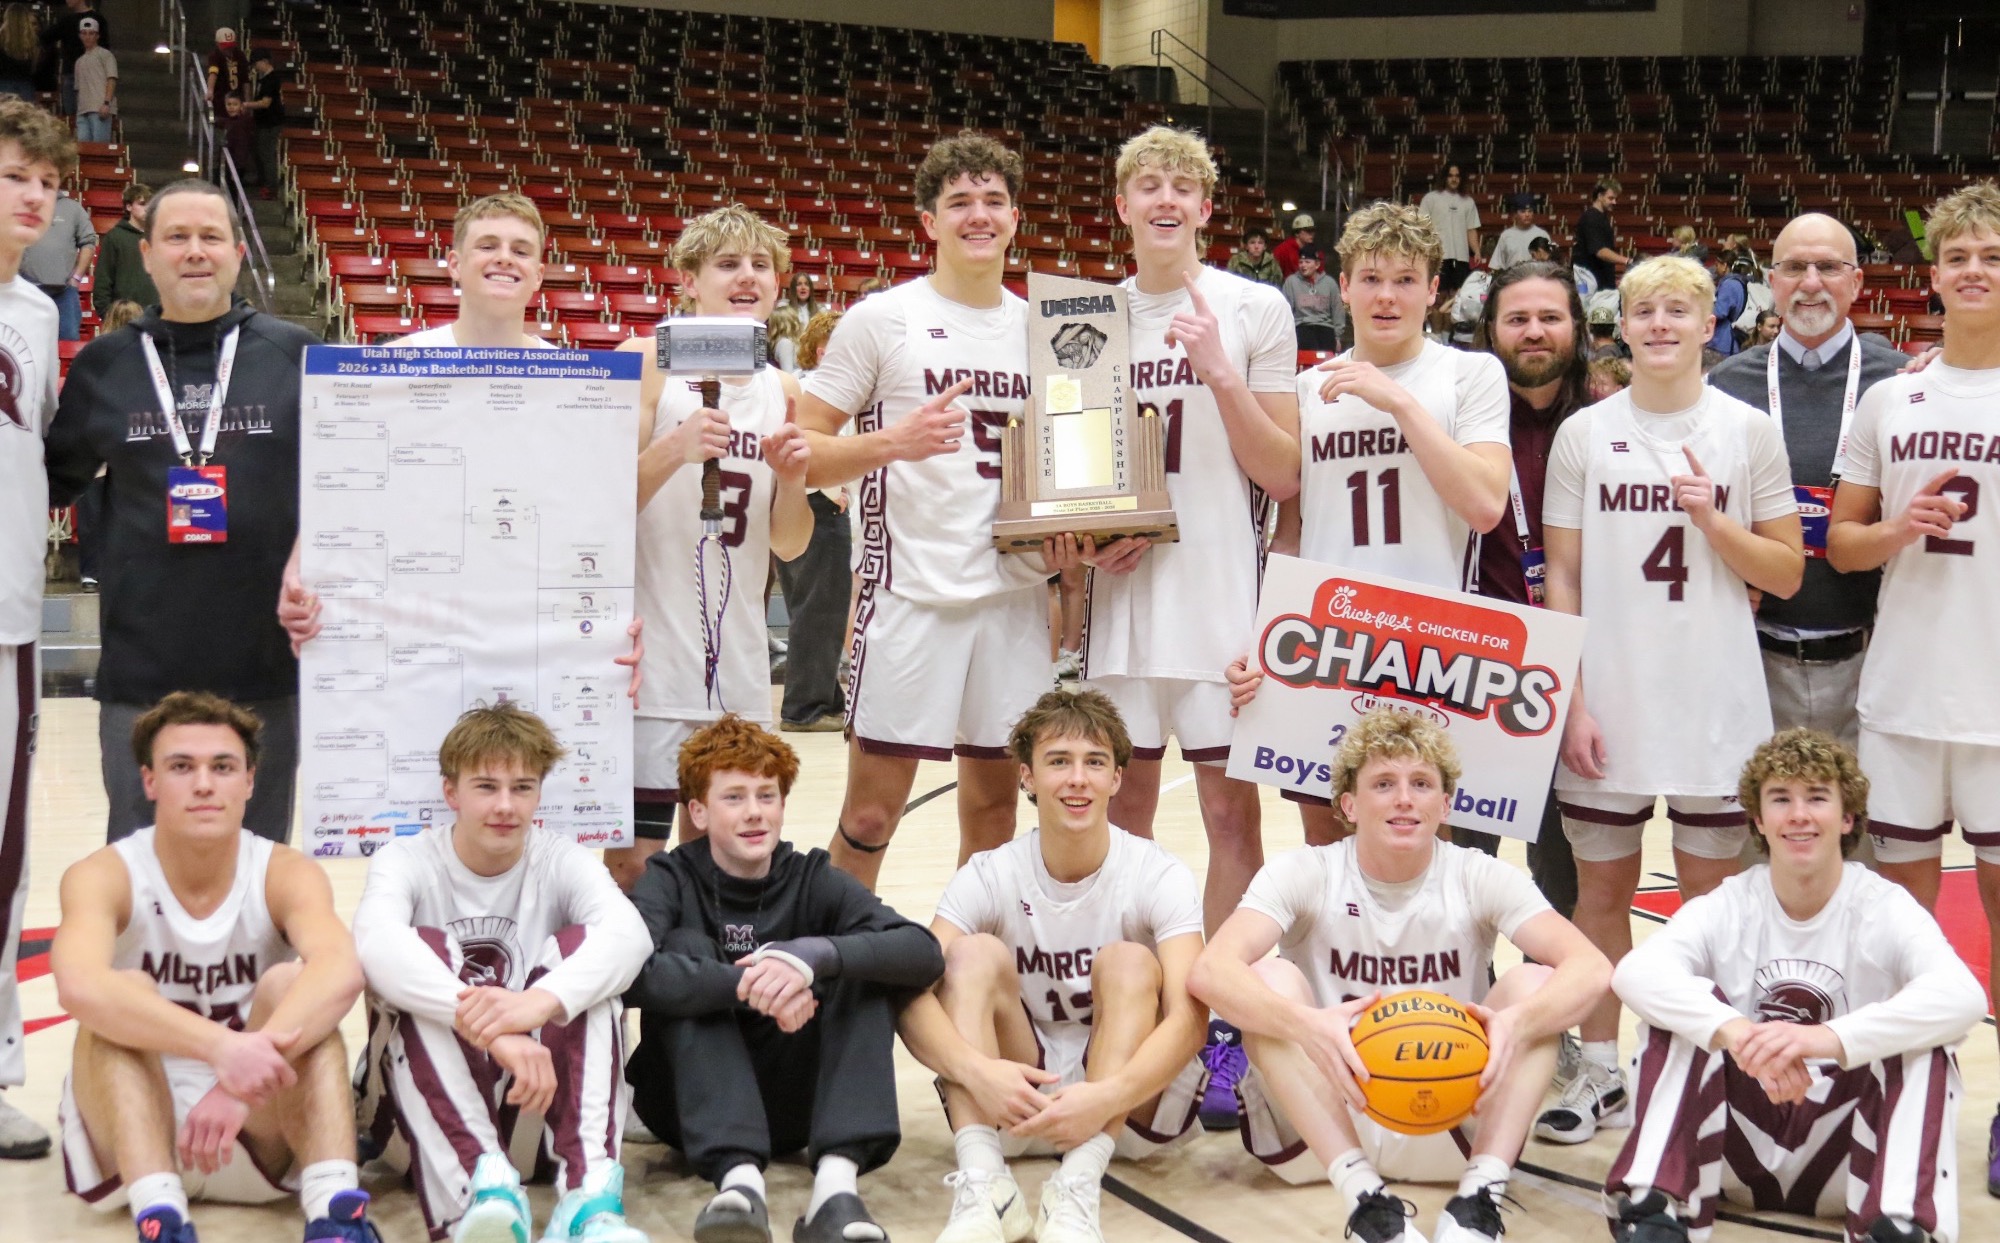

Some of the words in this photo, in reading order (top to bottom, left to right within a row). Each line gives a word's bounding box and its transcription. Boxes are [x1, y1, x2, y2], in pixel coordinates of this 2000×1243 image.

[363, 348, 390, 359] Utah
[393, 349, 421, 361] High
[423, 349, 462, 359] School
[464, 349, 519, 360] Activities
[522, 351, 589, 361] Association
[338, 362, 368, 373] 2026
[380, 364, 396, 374] 3A
[399, 364, 428, 376] Boys
[431, 364, 492, 375] Basketball
[496, 365, 524, 375] State
[528, 365, 611, 378] Championship
[924, 368, 1031, 400] MORGA
[1130, 357, 1204, 390] RGA
[177, 401, 212, 410] MORGA
[184, 384, 213, 401] M
[1113, 364, 1125, 491] CHAMPIONSHIP
[1043, 425, 1052, 477] STATE
[1312, 427, 1413, 463] MORGA
[1891, 431, 2000, 464] MORGA
[1346, 467, 1402, 547] 11
[1600, 483, 1731, 513] MORN
[184, 533, 212, 542] COACH
[1641, 525, 1689, 602] 4
[1418, 621, 1479, 644] CHICKEN
[1481, 634, 1510, 651] FOR
[1263, 617, 1556, 732] CHAMPS
[1253, 746, 1331, 785] Boys
[574, 805, 602, 814] Agraria
[577, 829, 608, 843] Wendy's
[725, 924, 754, 944] M
[725, 942, 759, 952] ORGA
[1016, 944, 1101, 981] MORG
[1330, 947, 1461, 986] MORGAN
[1372, 997, 1468, 1024] Wilson
[1395, 1041, 1454, 1061] EVO
